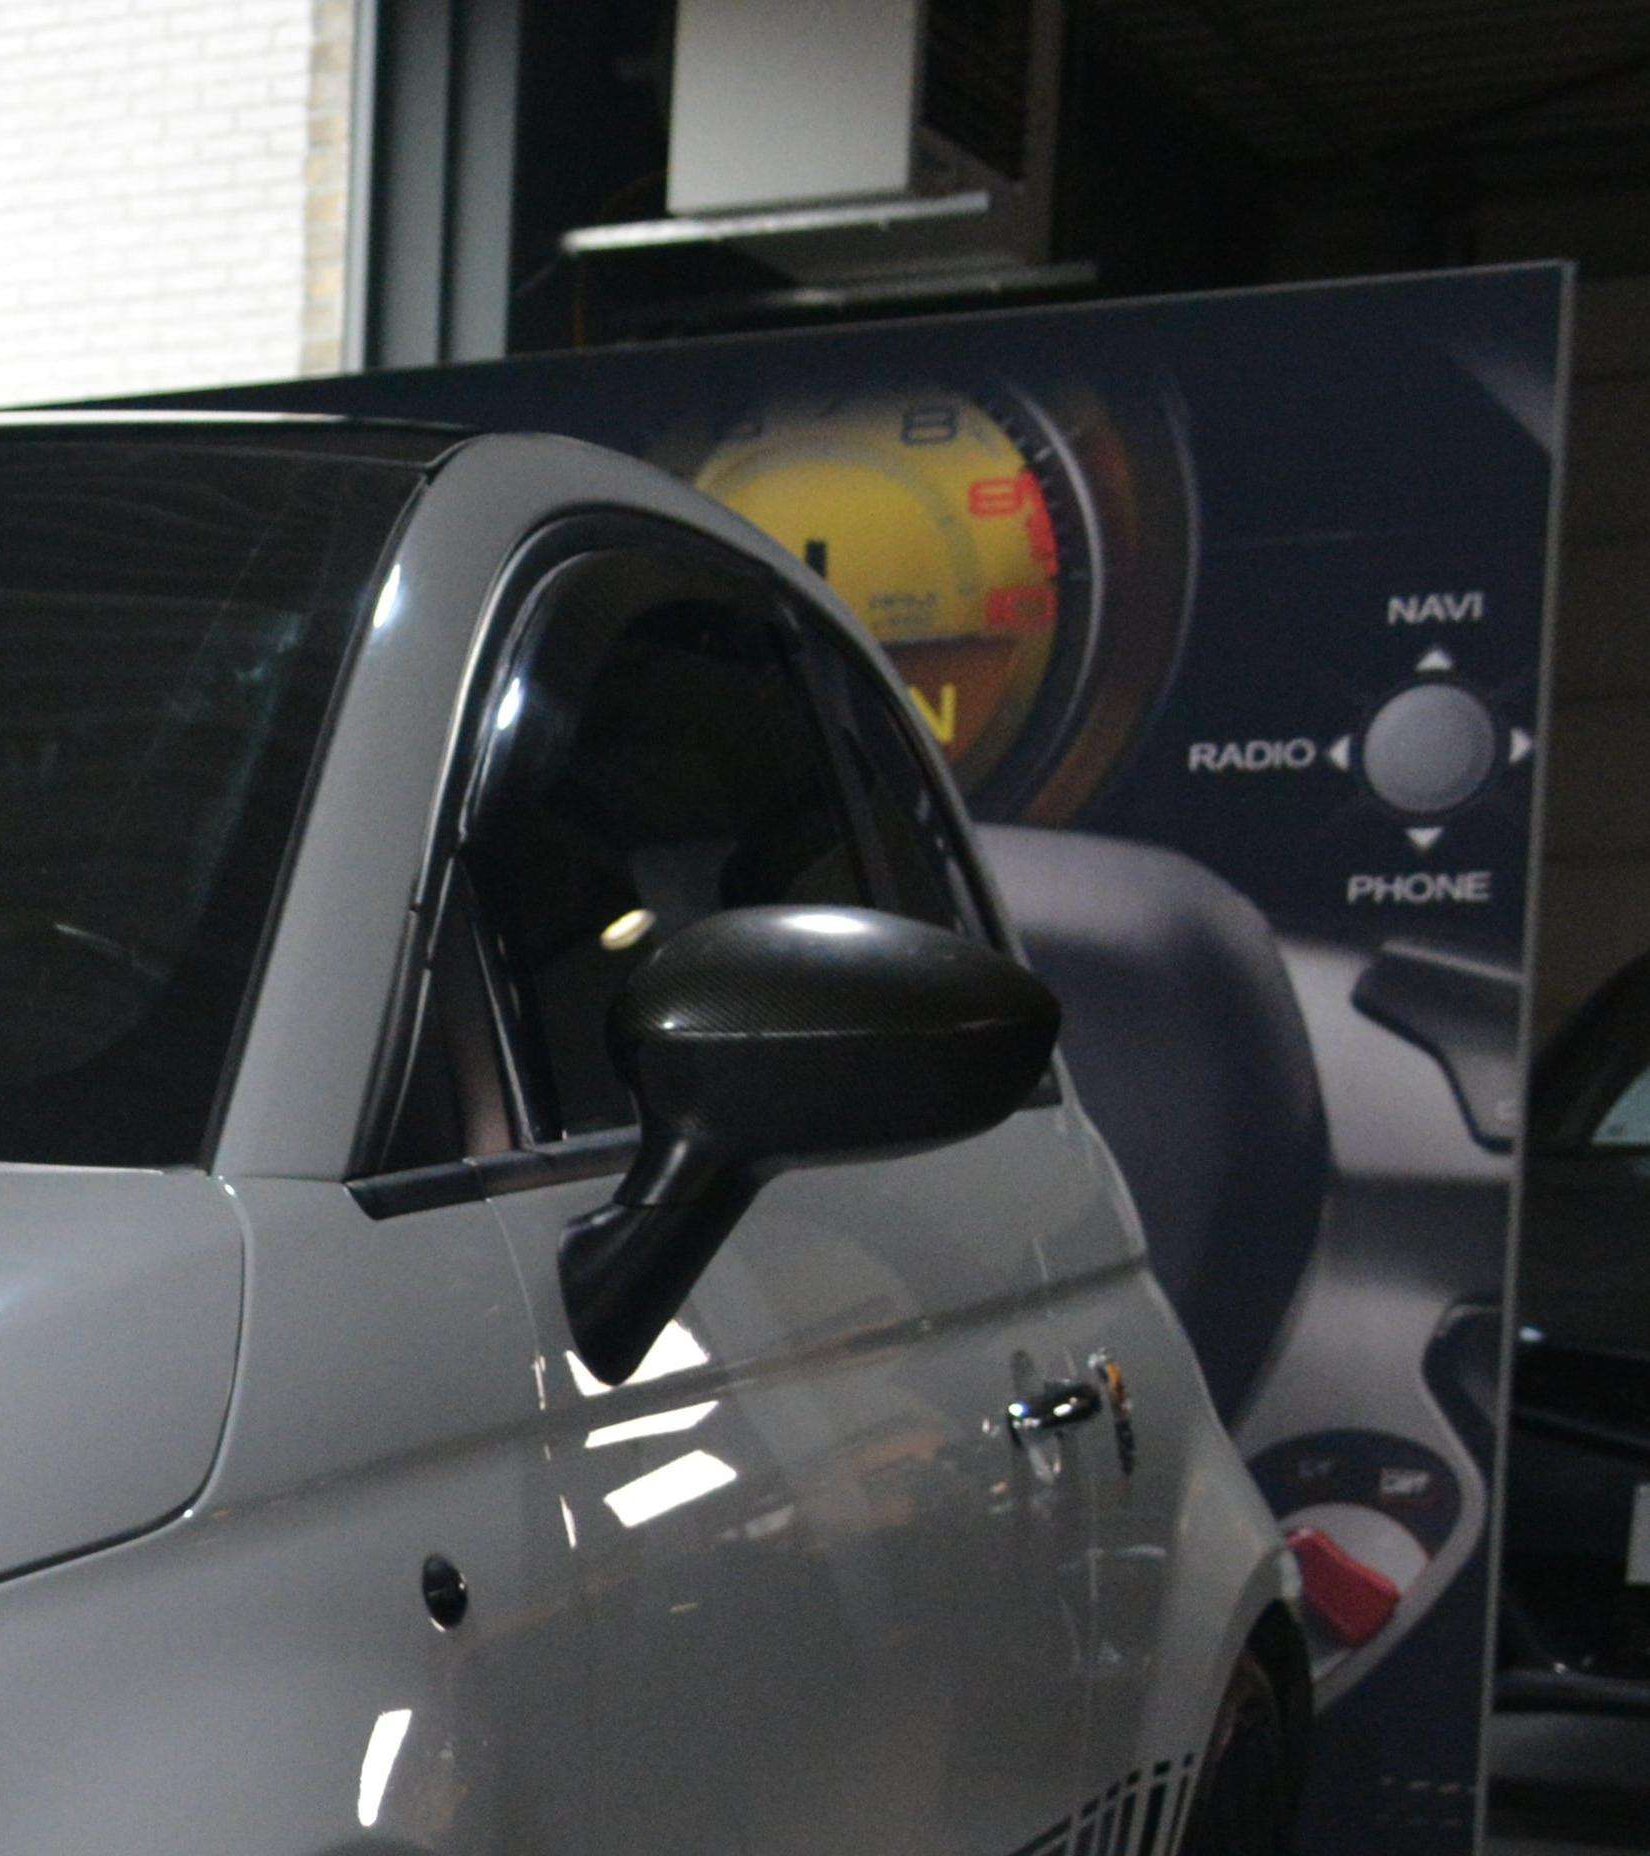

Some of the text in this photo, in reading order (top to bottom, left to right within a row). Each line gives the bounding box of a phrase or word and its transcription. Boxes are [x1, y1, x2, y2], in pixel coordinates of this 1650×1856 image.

[1386, 591, 1485, 626] NAVI
[1187, 737, 1317, 773] RADIO
[1346, 871, 1492, 905] PHONE
